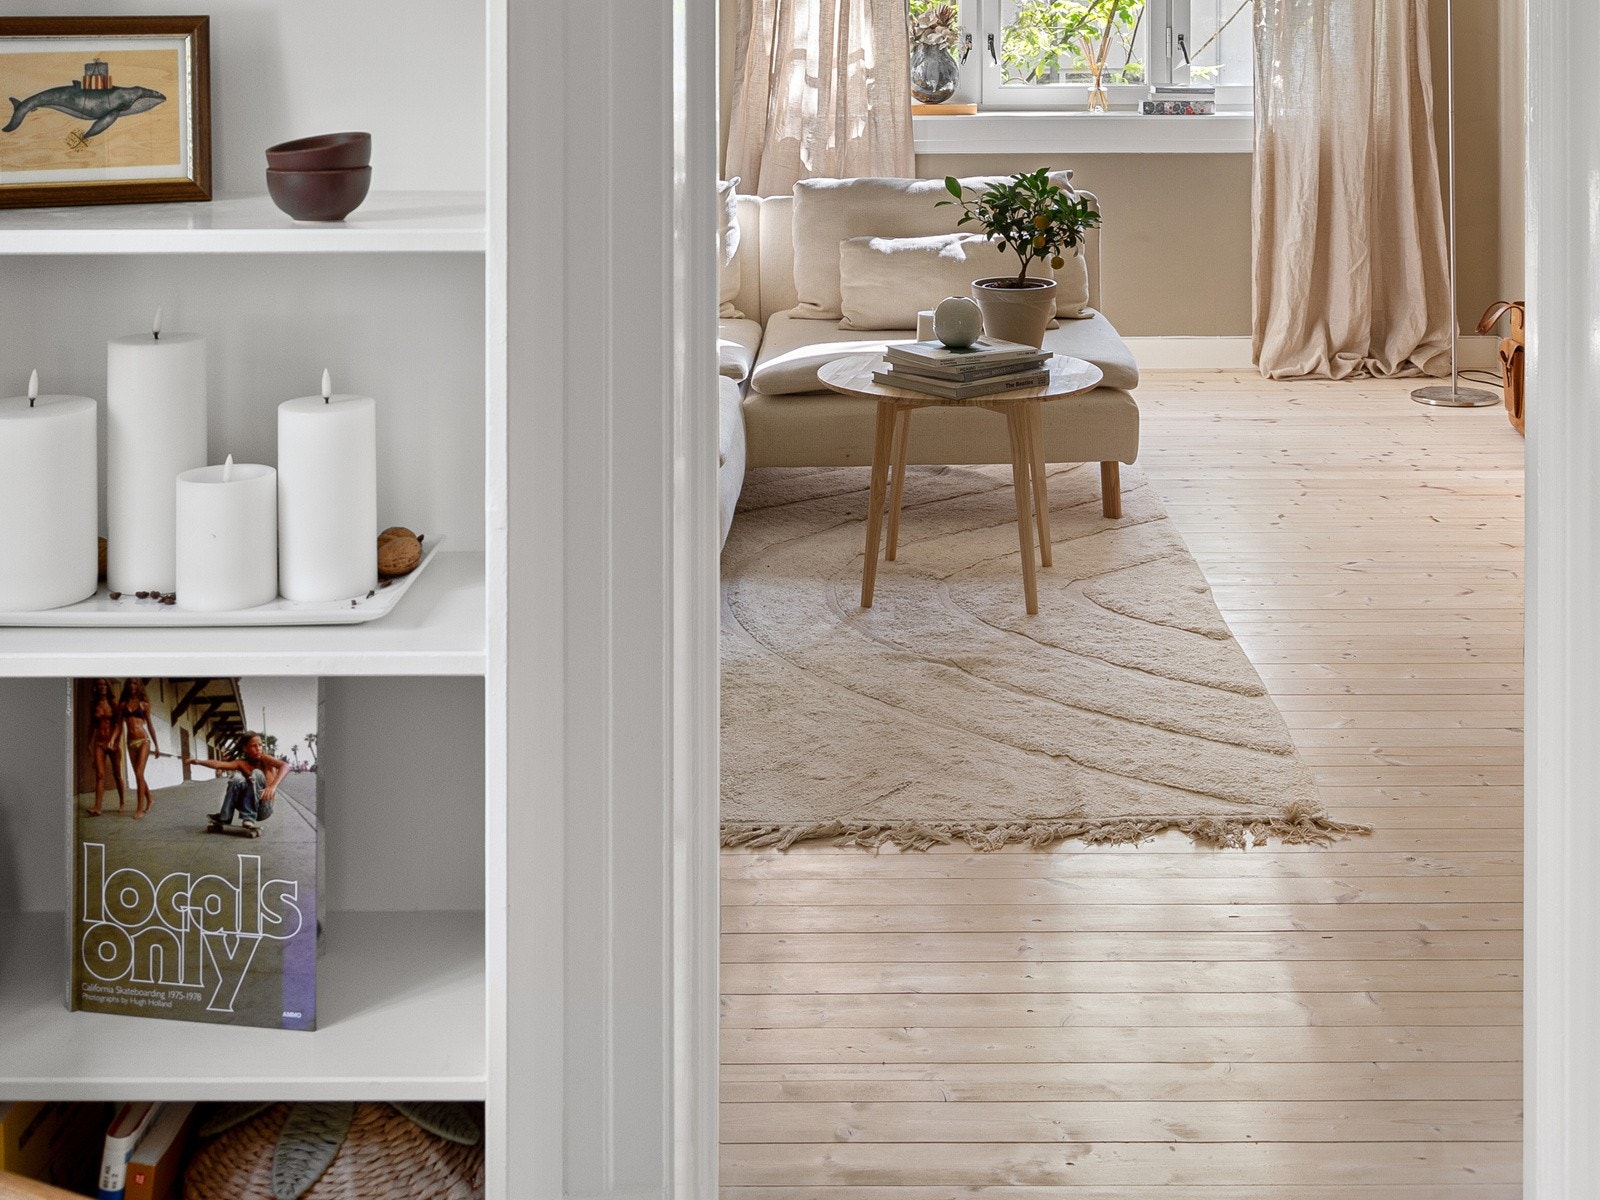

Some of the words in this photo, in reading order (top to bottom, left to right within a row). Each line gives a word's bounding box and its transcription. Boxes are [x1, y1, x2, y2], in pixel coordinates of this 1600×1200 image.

[83, 842, 302, 939] locals
[81, 905, 263, 1012] only
[81, 982, 114, 994] California
[115, 985, 166, 1000] Skateboarding
[168, 990, 202, 1002] 1975-1978
[81, 993, 120, 1004] Photographs
[120, 997, 128, 1005] by
[129, 997, 147, 1007] Hugh
[148, 999, 173, 1008] Holland
[282, 1011, 302, 1019] AMMO
